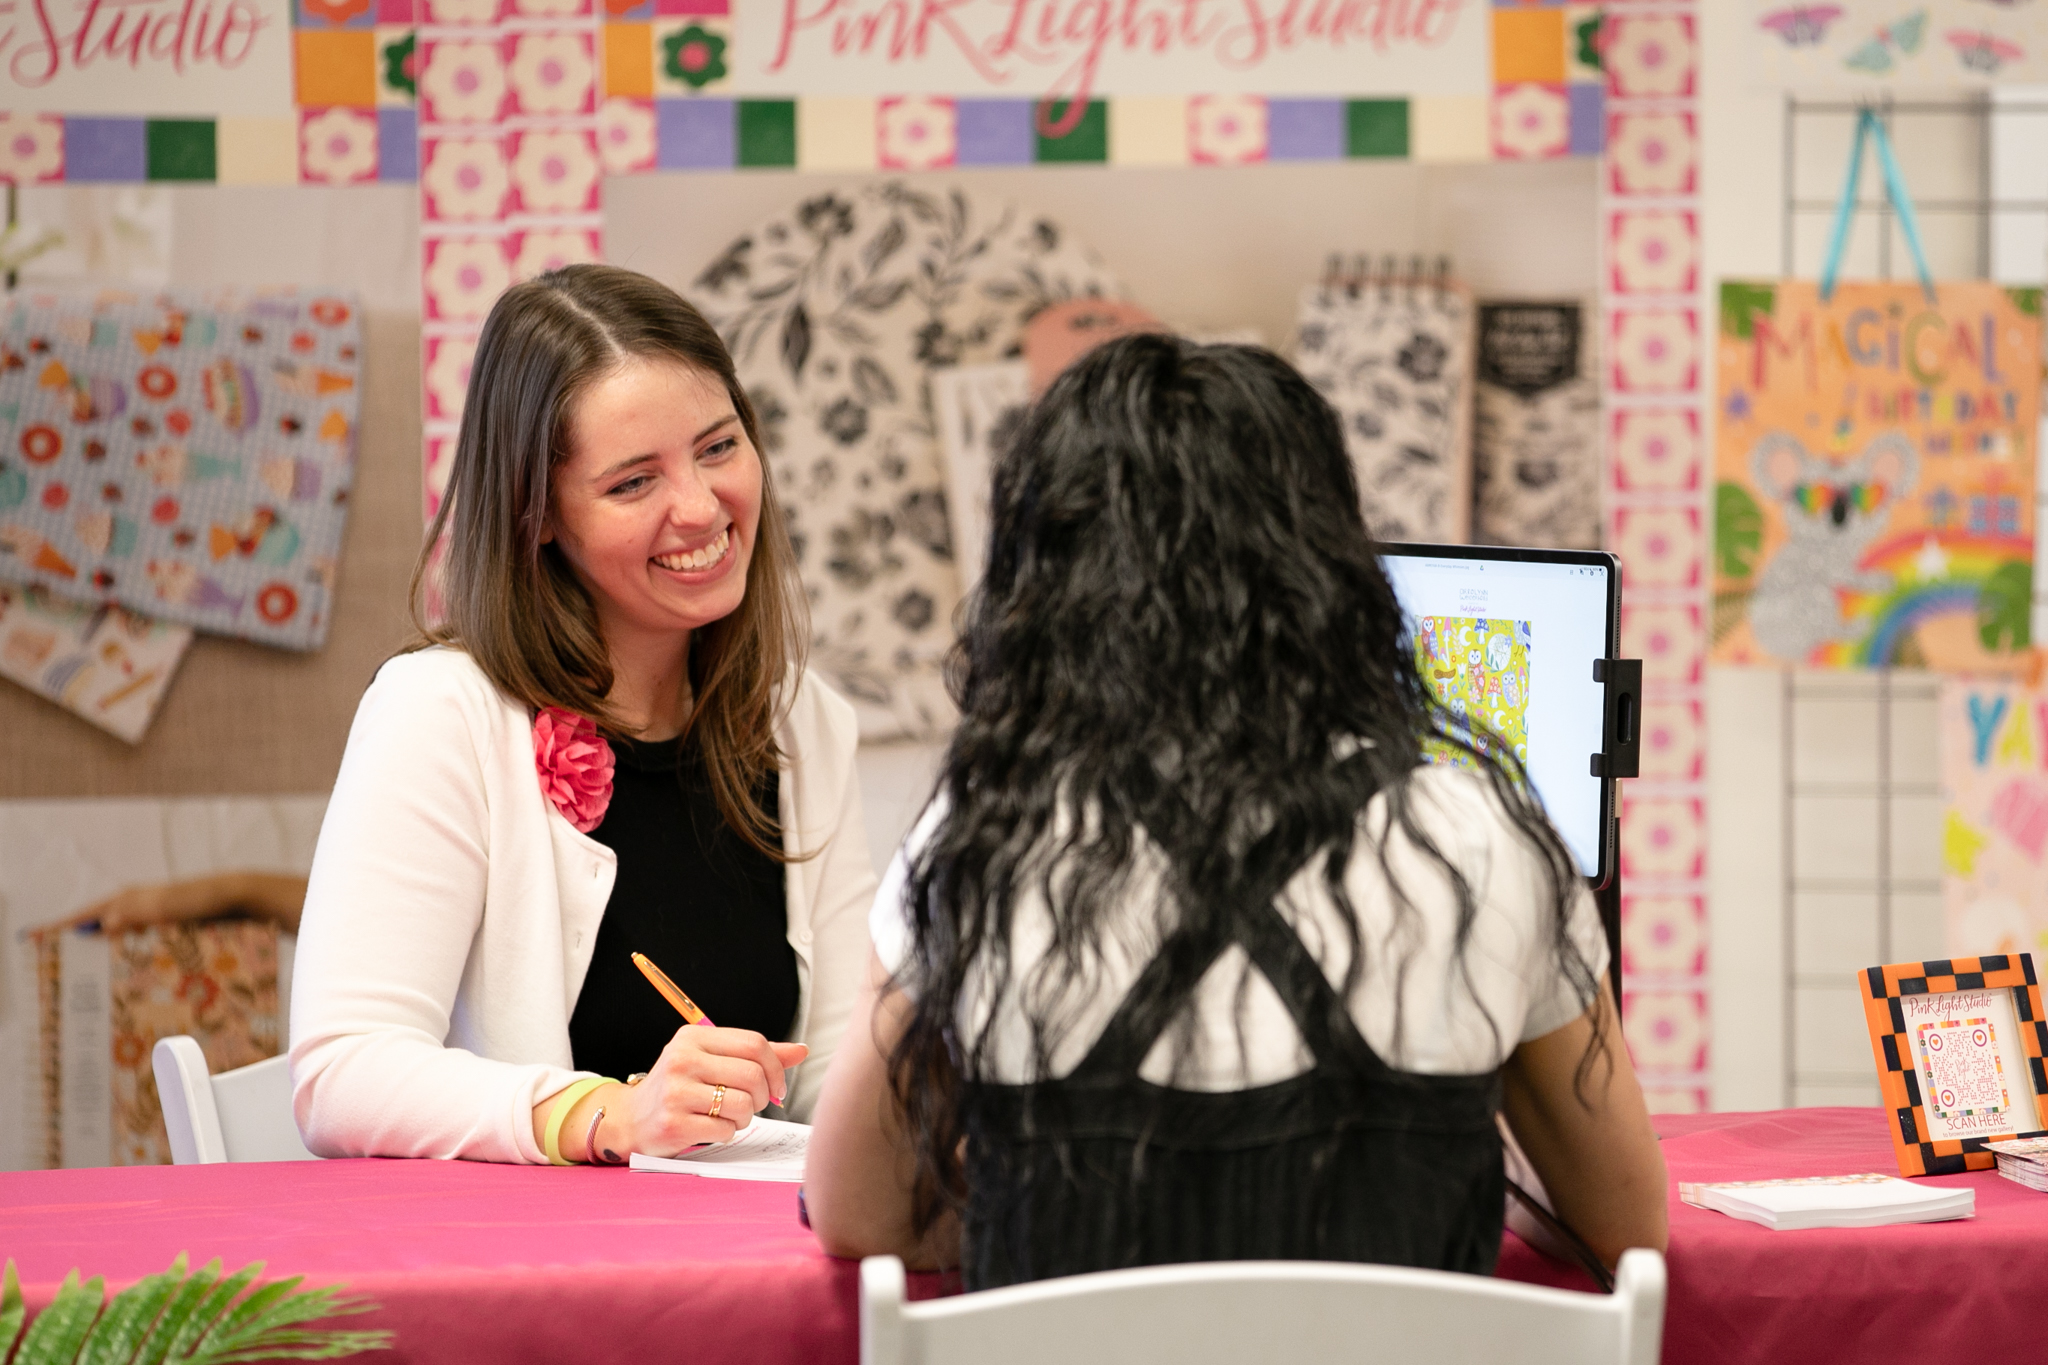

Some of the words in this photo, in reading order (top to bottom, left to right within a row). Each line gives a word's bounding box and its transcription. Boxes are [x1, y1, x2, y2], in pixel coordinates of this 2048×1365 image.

[1946, 1116, 1977, 1131] SCAN
[1977, 1113, 2007, 1127] HERE
[1973, 1127, 1988, 1135] brand
